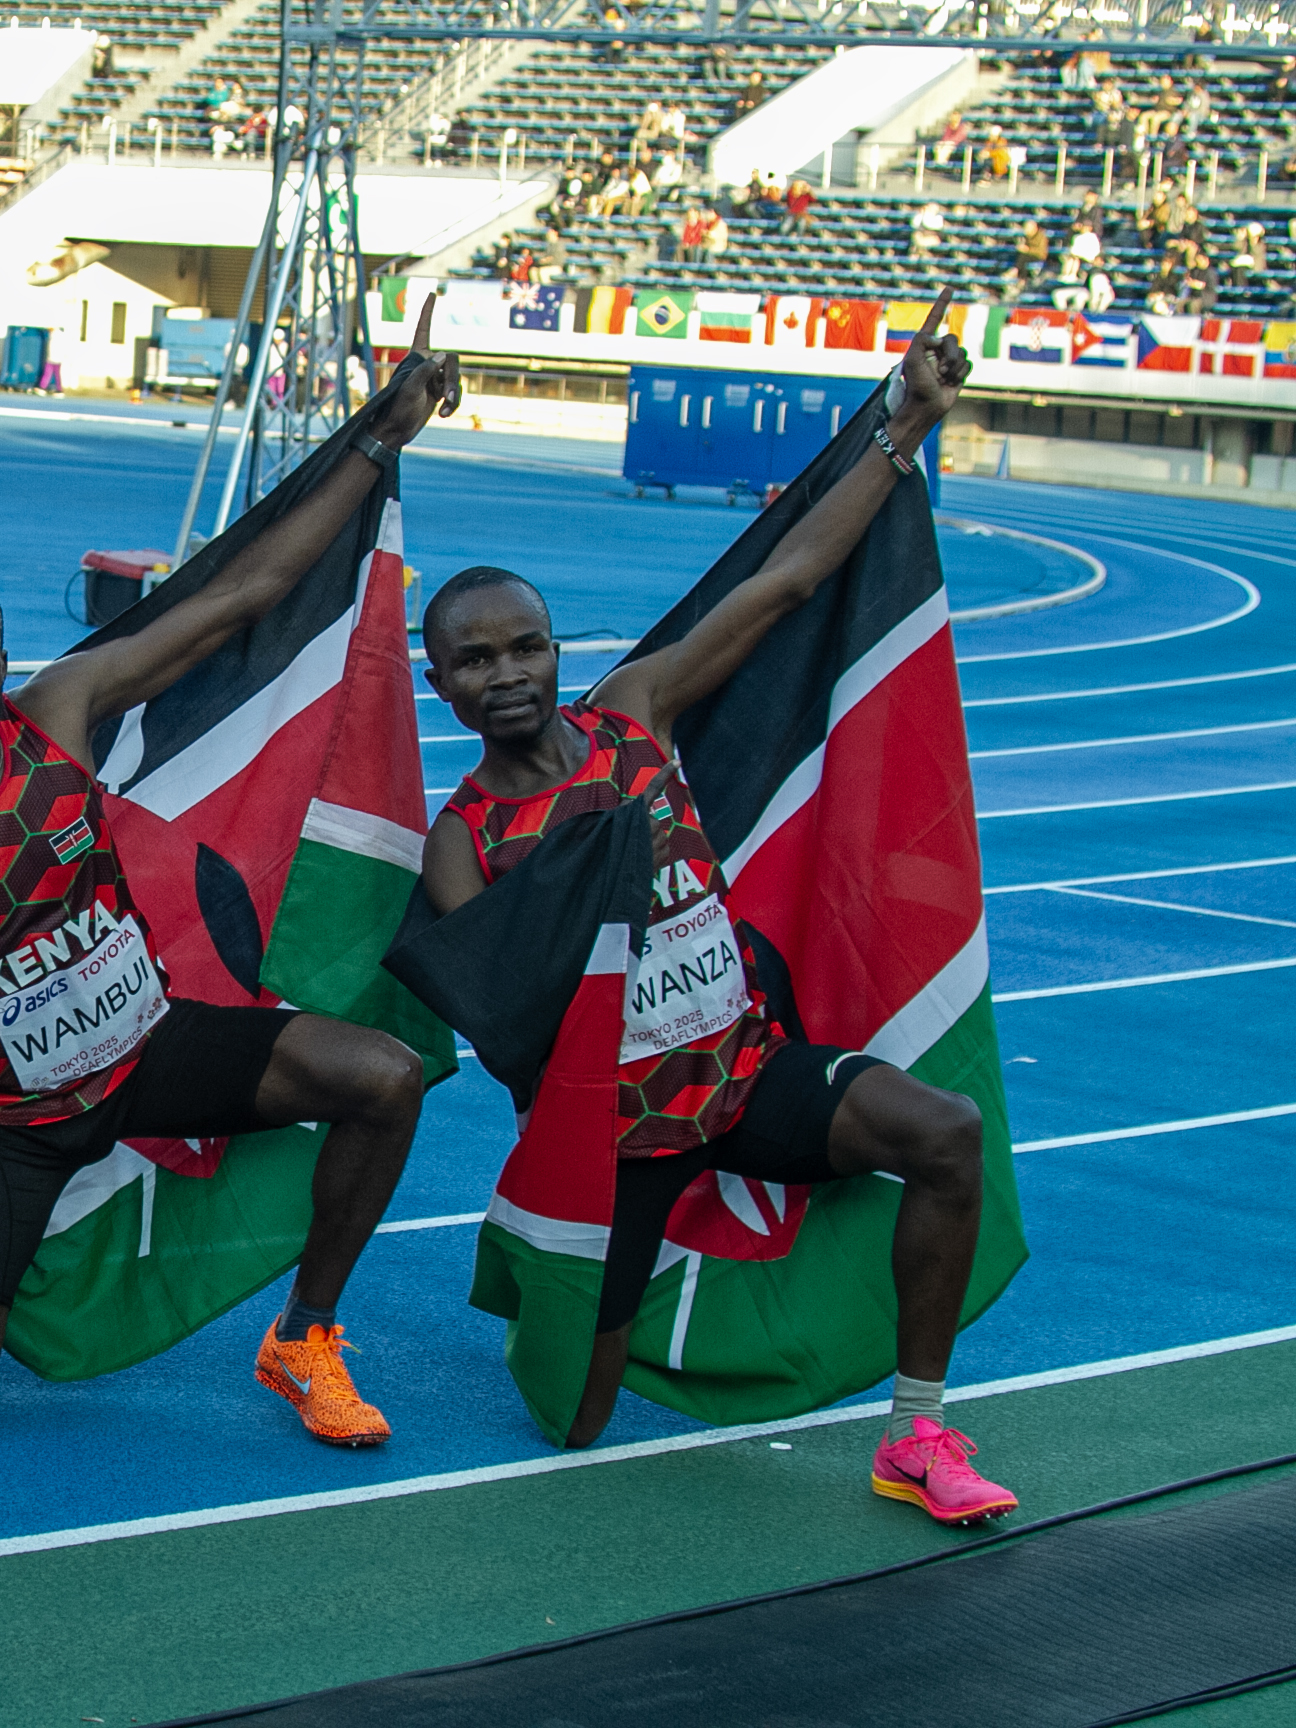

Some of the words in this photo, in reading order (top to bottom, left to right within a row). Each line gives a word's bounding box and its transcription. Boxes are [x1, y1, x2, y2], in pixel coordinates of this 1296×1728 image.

[661, 902, 723, 943] TOYOTA
[77, 928, 136, 982] TOYOTA
[631, 939, 738, 1015] WANZA
[11, 956, 149, 1064] WAMBUI
[629, 1022, 672, 1044] TOKYO
[673, 1010, 704, 1029] 2025
[653, 1010, 733, 1051] DEAFLYMPICS
[50, 1050, 89, 1077] TOKYO
[90, 1035, 119, 1057] 2025
[72, 1025, 143, 1078] DEAFLYMPICS
